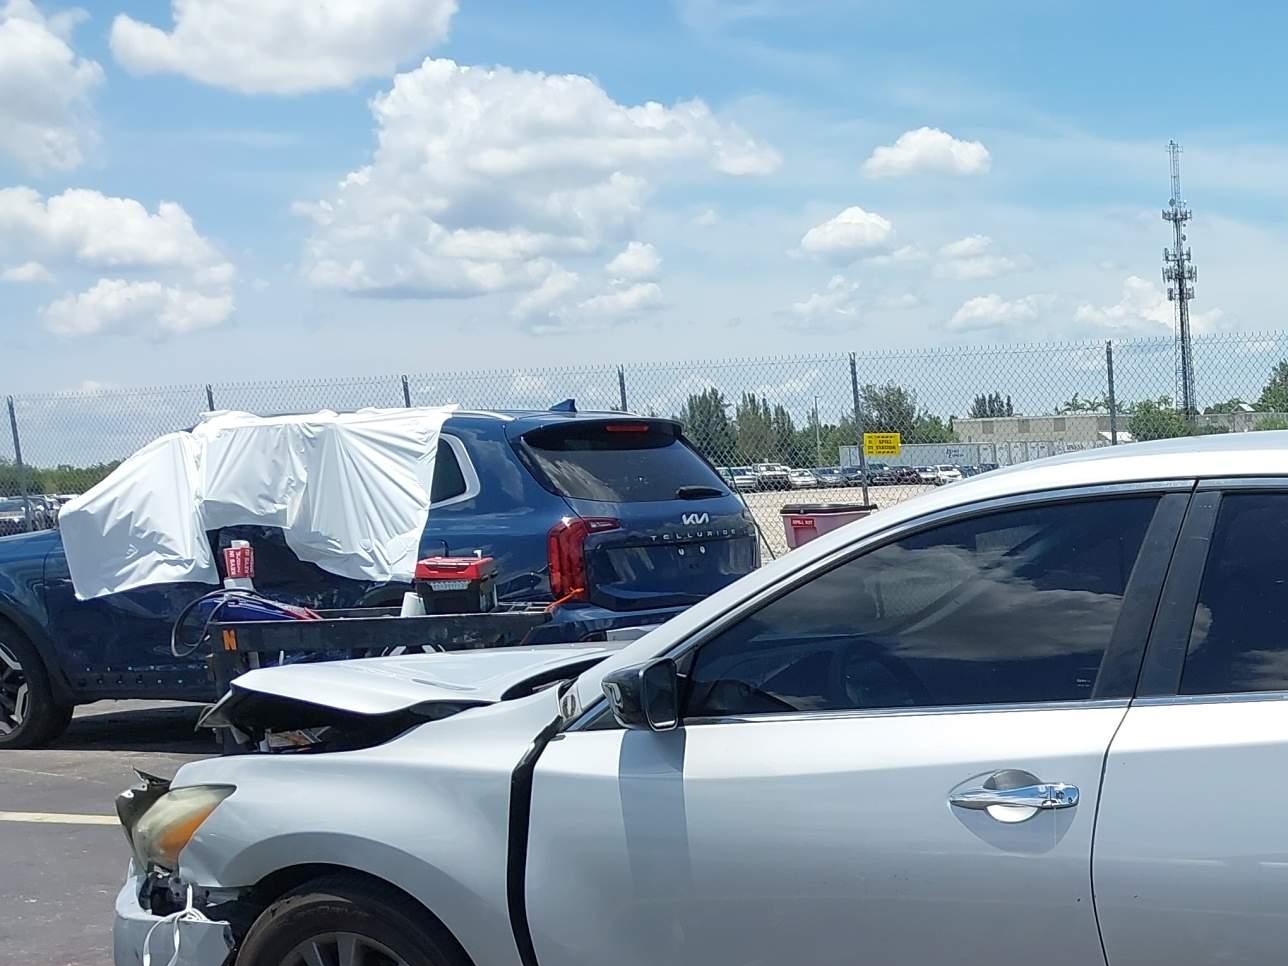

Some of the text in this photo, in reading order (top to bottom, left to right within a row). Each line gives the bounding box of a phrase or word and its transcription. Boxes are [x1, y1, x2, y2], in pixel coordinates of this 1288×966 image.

[681, 512, 709, 525] KIA
[650, 528, 736, 541] TELLURIDE
[222, 629, 237, 650] N
